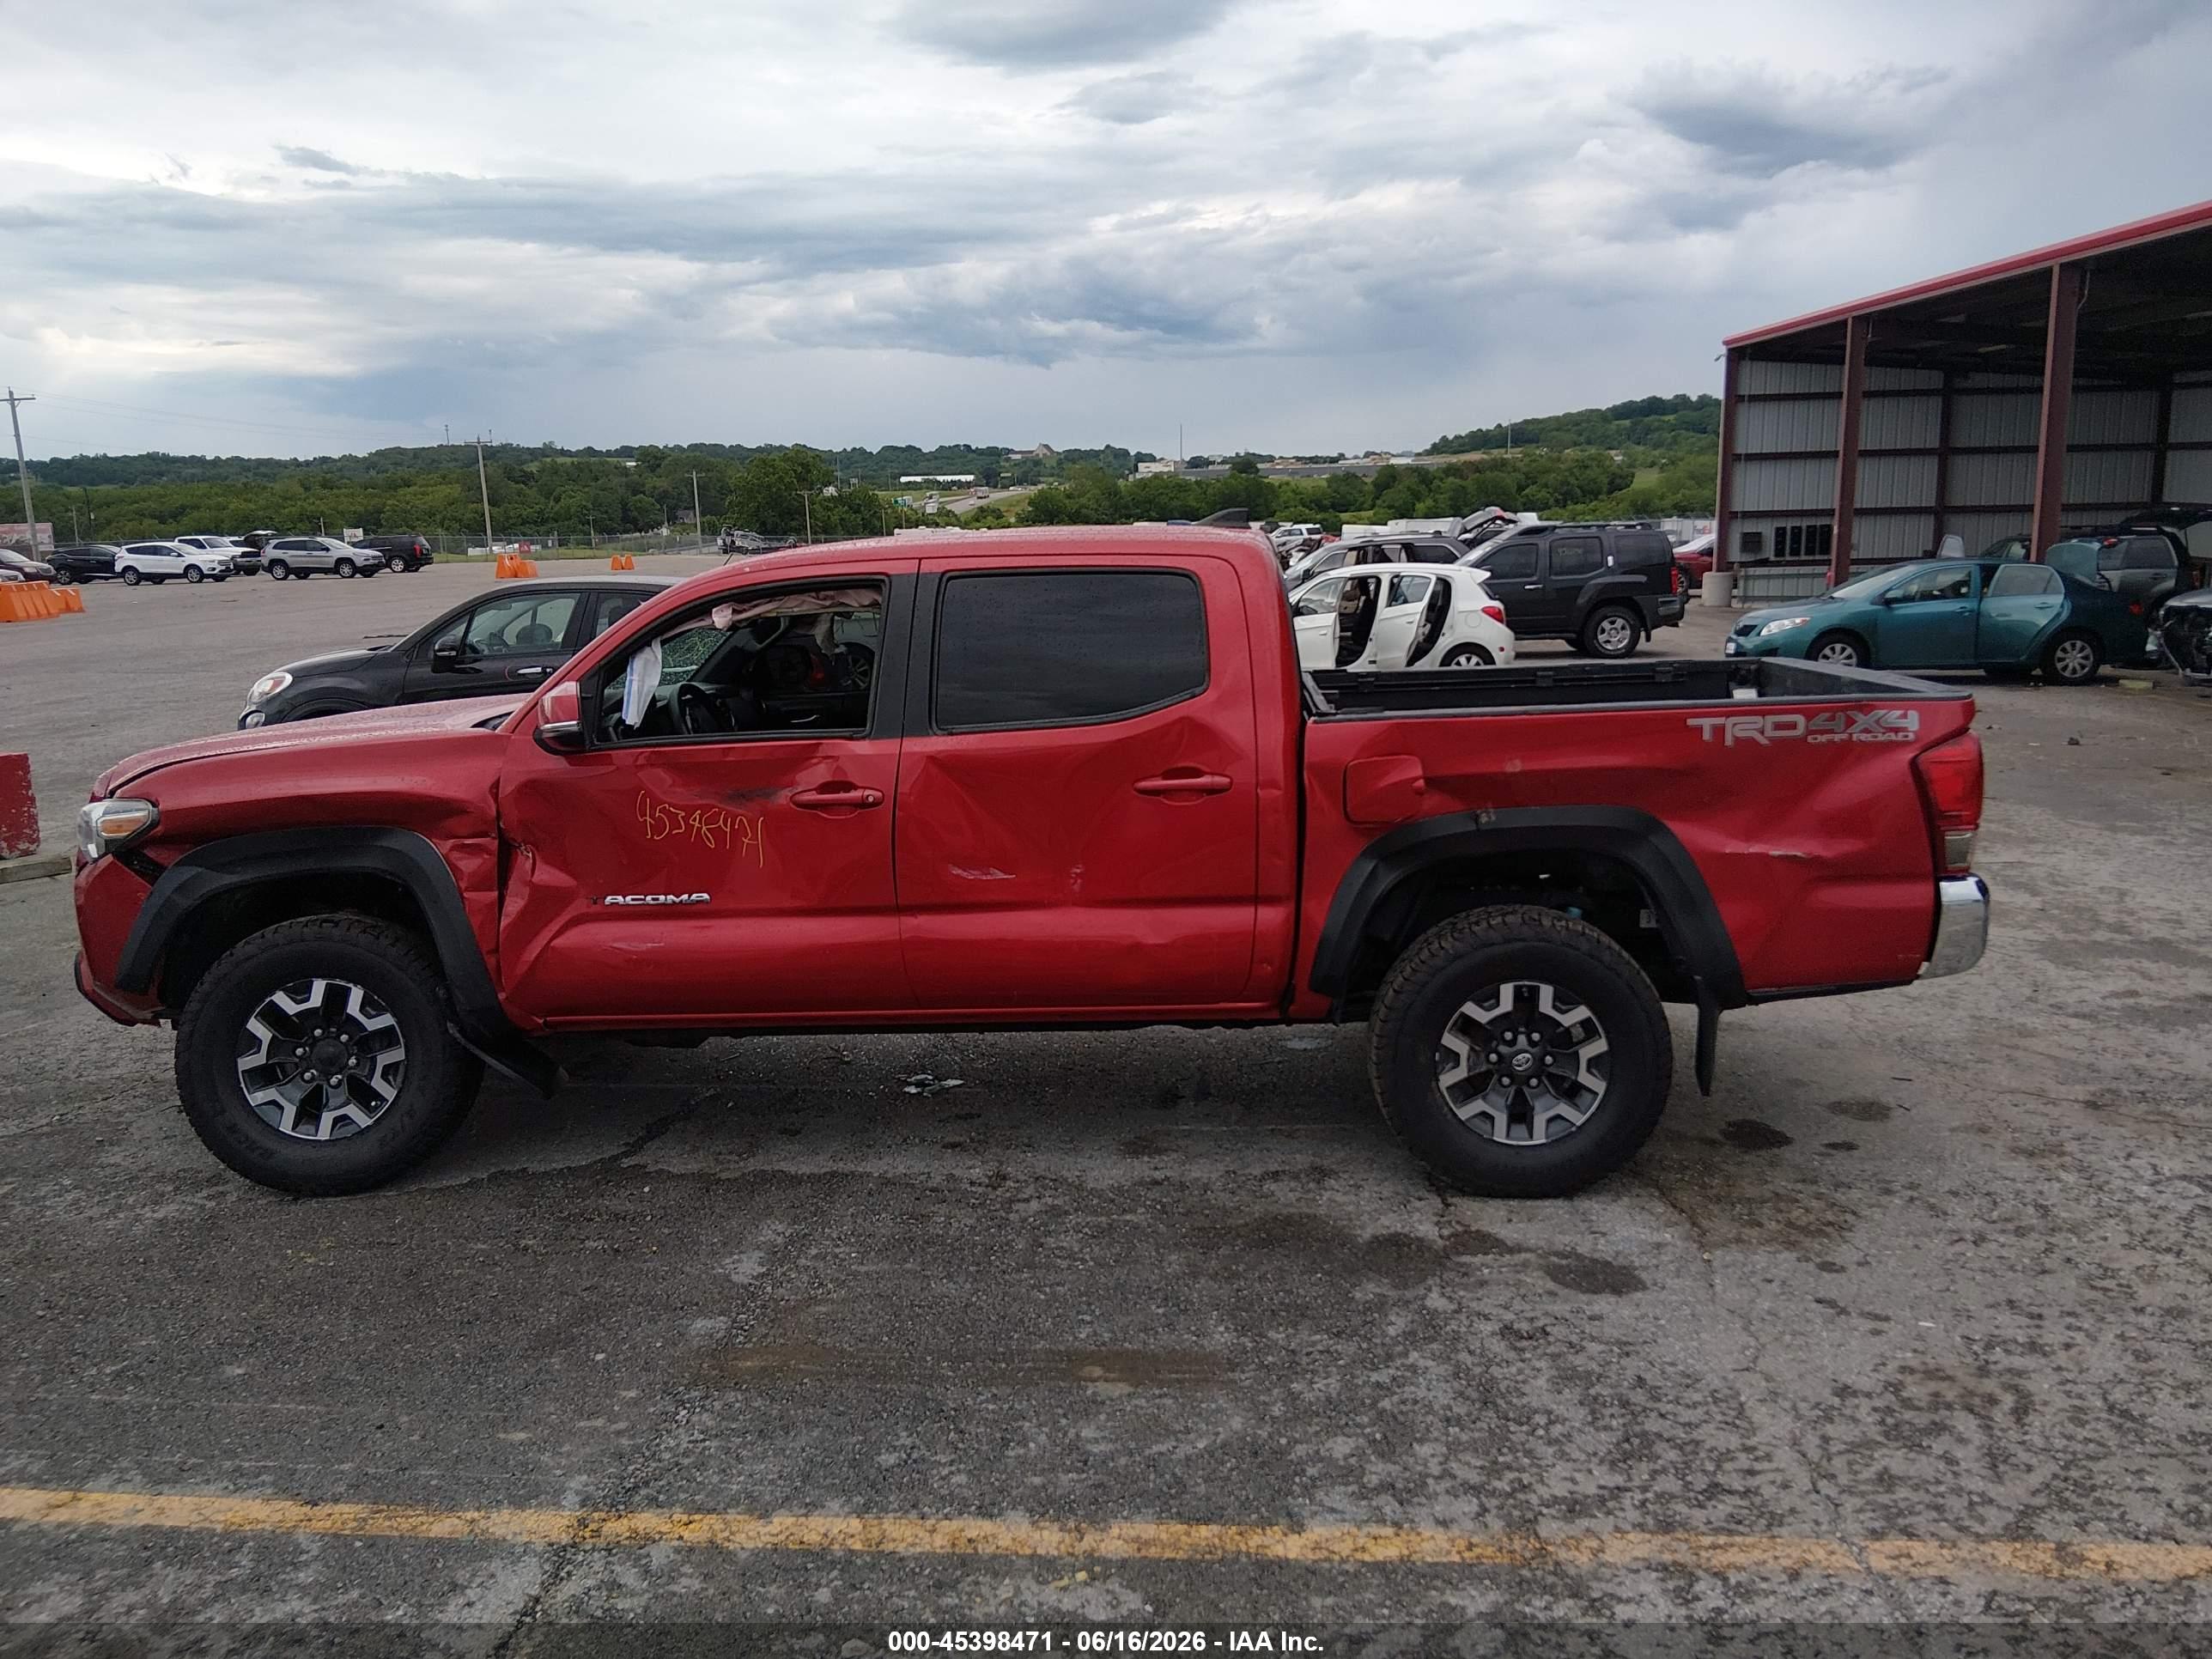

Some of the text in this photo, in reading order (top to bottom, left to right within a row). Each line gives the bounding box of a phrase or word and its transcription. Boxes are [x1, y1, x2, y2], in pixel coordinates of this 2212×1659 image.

[1686, 714, 1807, 747] TRD
[1807, 732, 1916, 744] OFF ROAD
